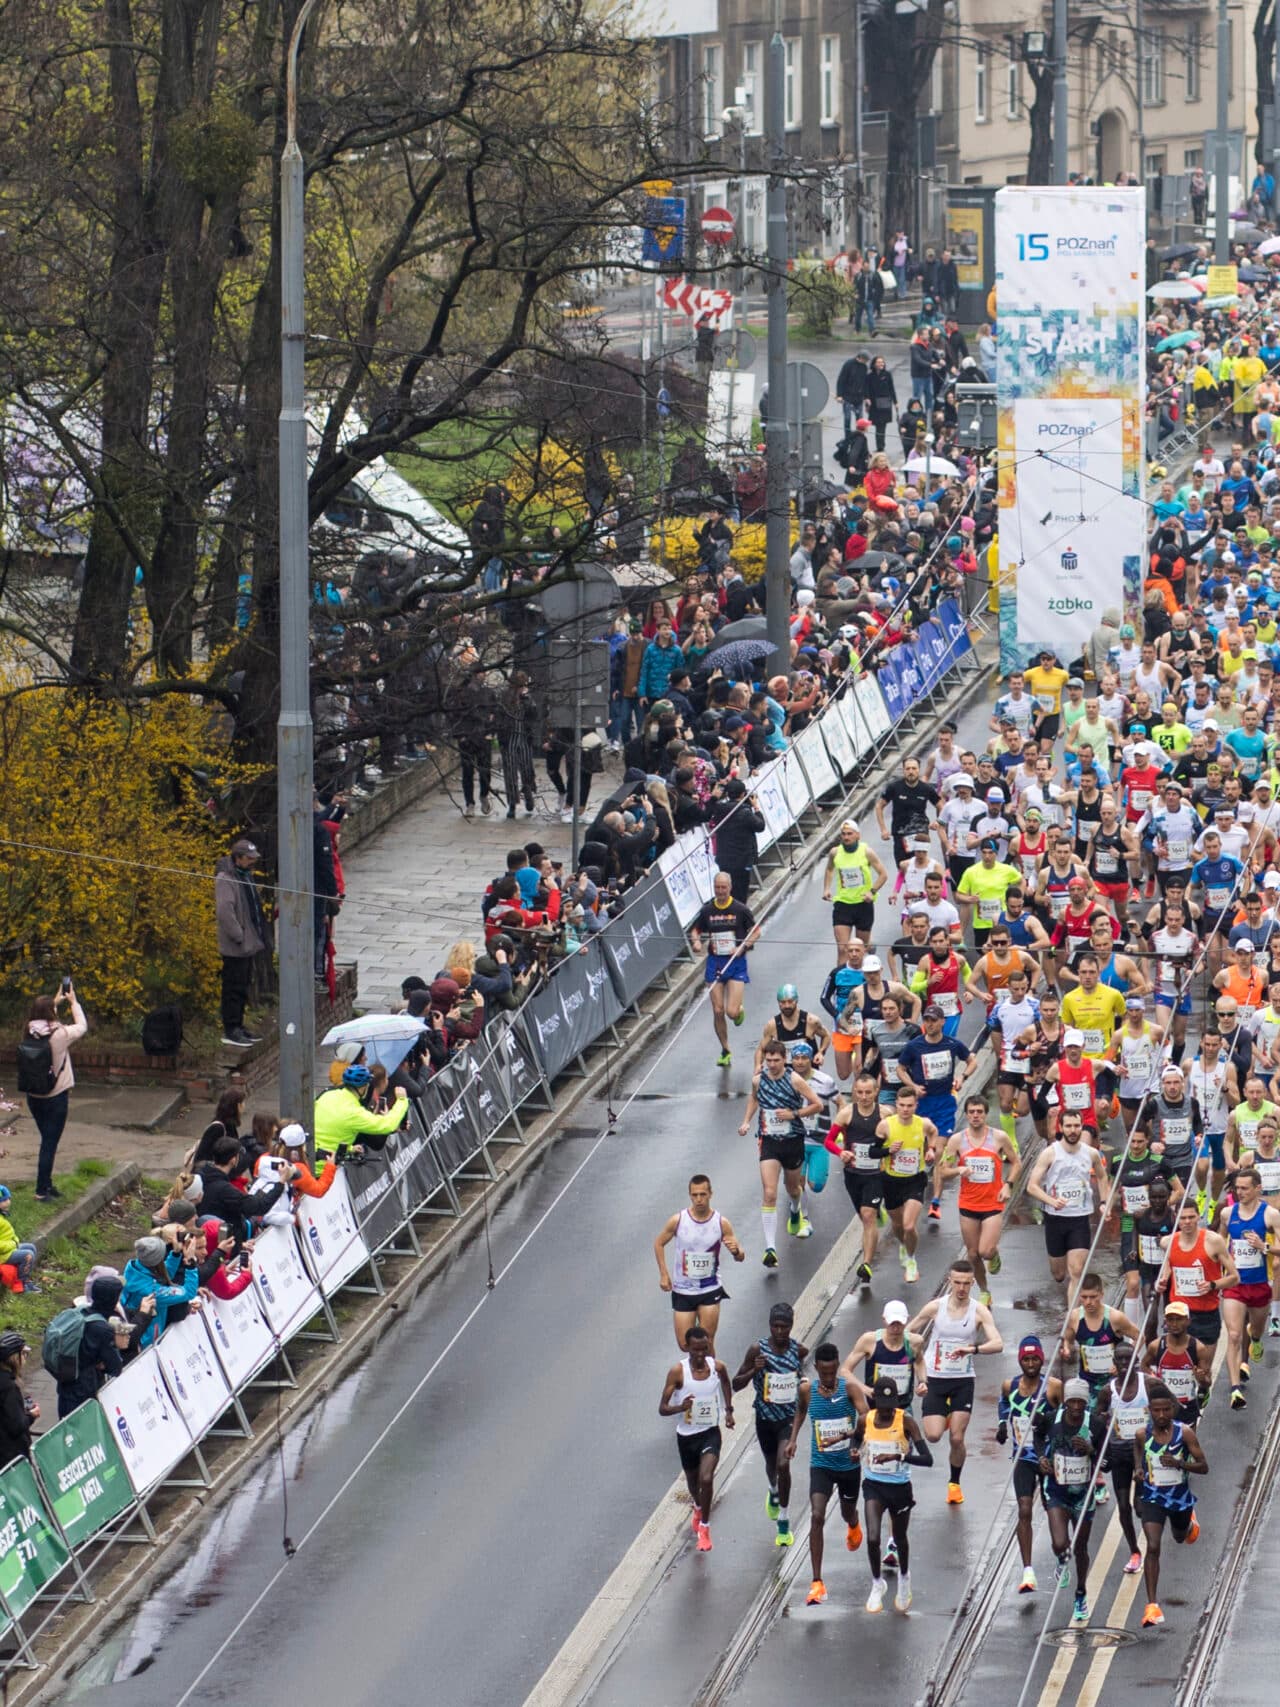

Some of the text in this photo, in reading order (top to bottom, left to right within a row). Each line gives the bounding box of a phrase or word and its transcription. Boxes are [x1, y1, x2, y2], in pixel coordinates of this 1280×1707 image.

[1016, 233, 1048, 261] 15
[1026, 331, 1108, 355] START
[1048, 597, 1093, 610] żabka
[1168, 1126, 1187, 1134] 2224
[692, 1259, 709, 1268] 1231
[772, 1382, 796, 1391] MAIYO
[1167, 1378, 1190, 1386] 7054
[700, 1406, 711, 1415] 22
